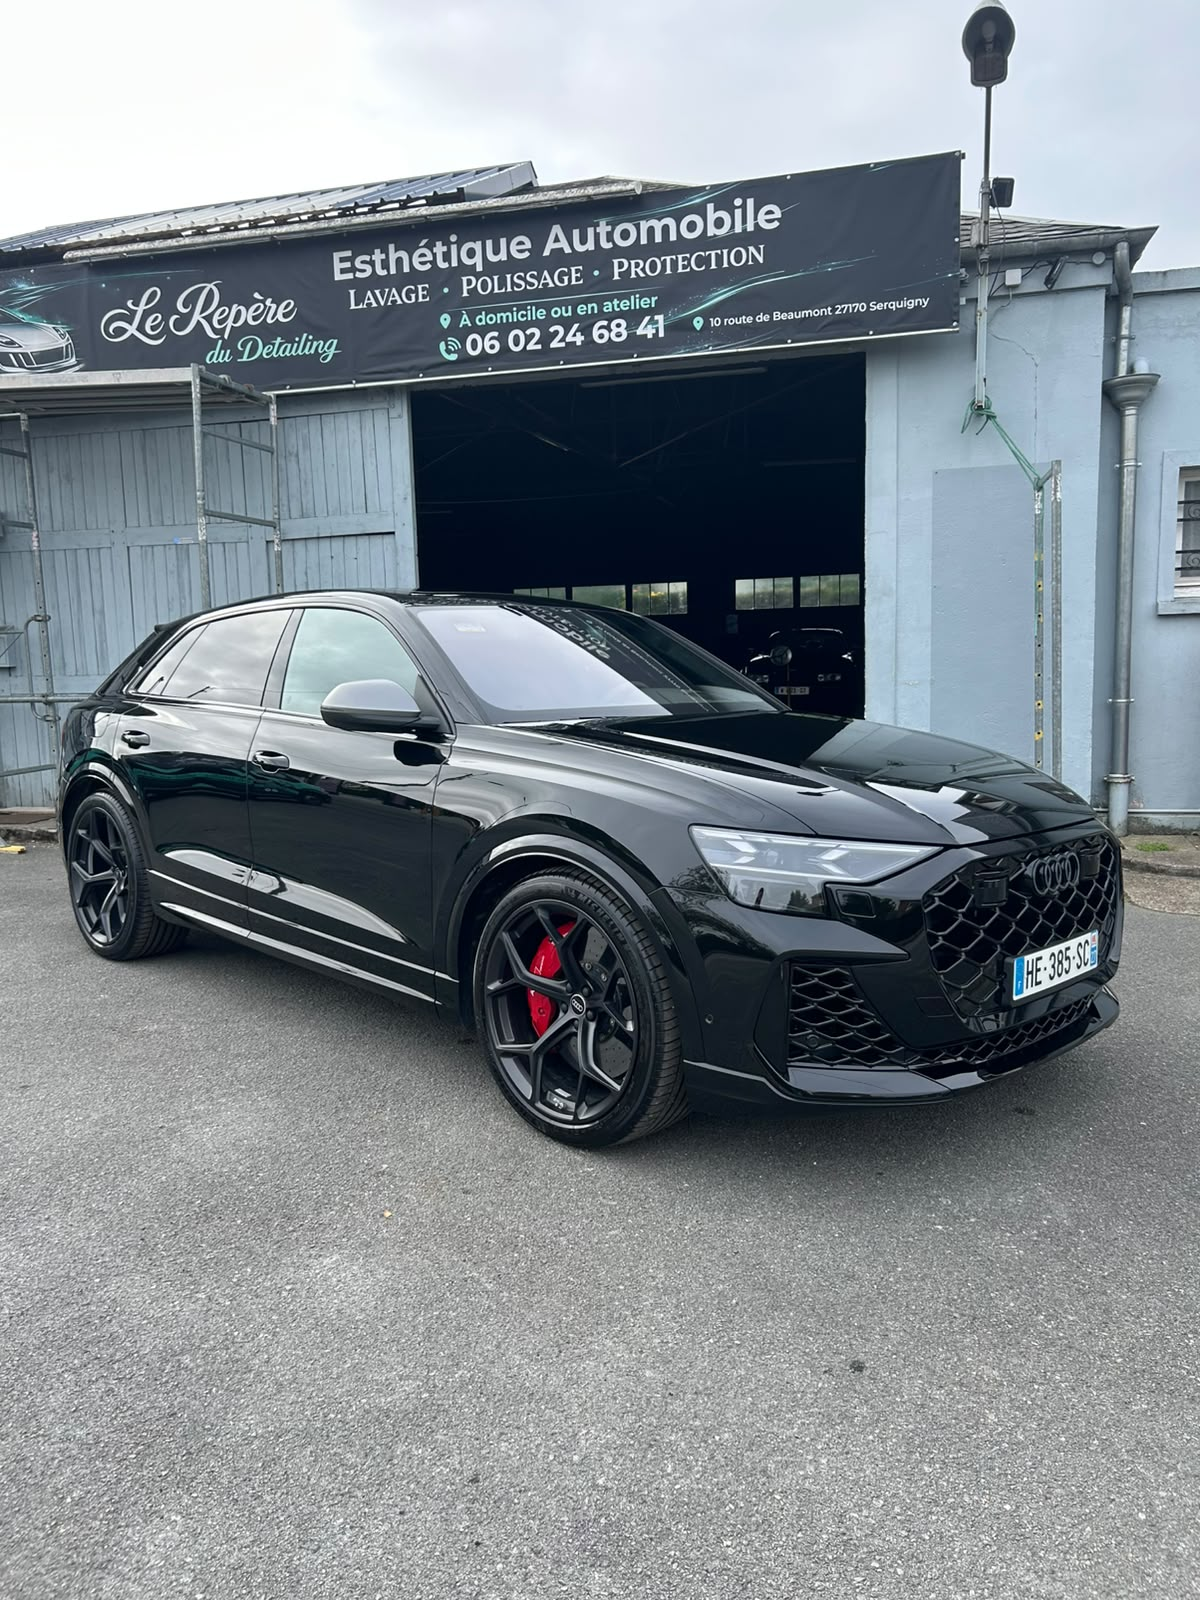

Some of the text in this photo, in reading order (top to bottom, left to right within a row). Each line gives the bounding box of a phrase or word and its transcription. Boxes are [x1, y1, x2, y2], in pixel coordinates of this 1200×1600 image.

[333, 198, 782, 281] Esthétique Automobile
[349, 245, 765, 309] LAVAGE POLISSAGE PROTECTION
[101, 281, 297, 345] Le Repère
[459, 294, 658, 328] À domicile ou en atelier
[709, 297, 930, 327] 10 route de Beaumont 27170 Serquigny
[206, 333, 342, 364] du Detailing
[466, 314, 665, 356] 06 02 24 68 41
[1025, 939, 1089, 989] HE-385-SC
